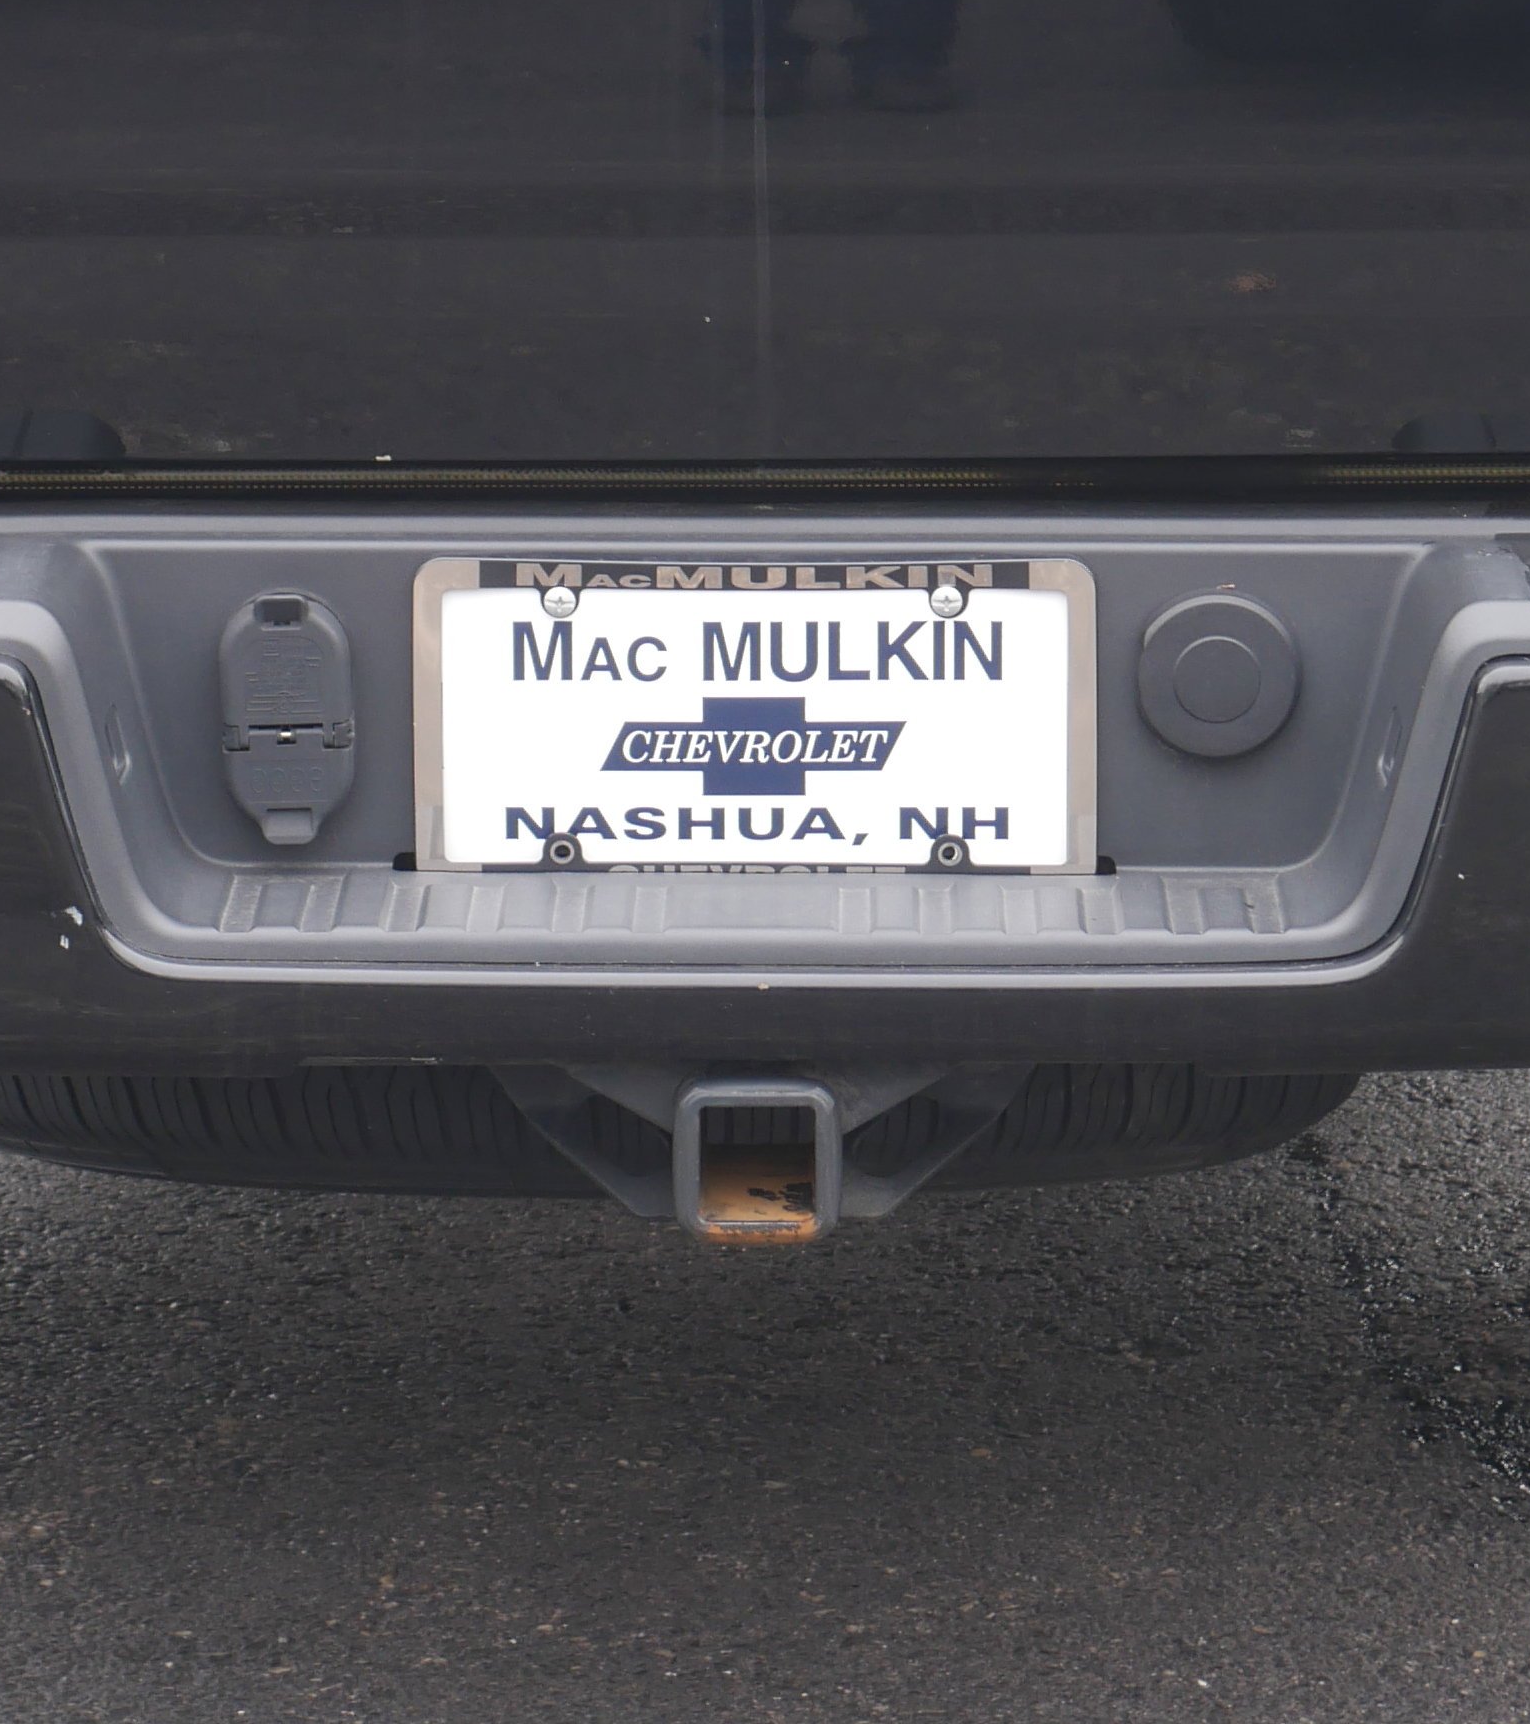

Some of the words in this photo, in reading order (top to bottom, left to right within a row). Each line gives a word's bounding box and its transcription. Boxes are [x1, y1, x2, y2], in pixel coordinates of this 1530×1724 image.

[512, 620, 669, 682] MAC
[701, 620, 1004, 682] MULKIN
[620, 729, 889, 764] CHEVROLET
[504, 806, 871, 847] NASHUA,
[898, 806, 1010, 841] NH
